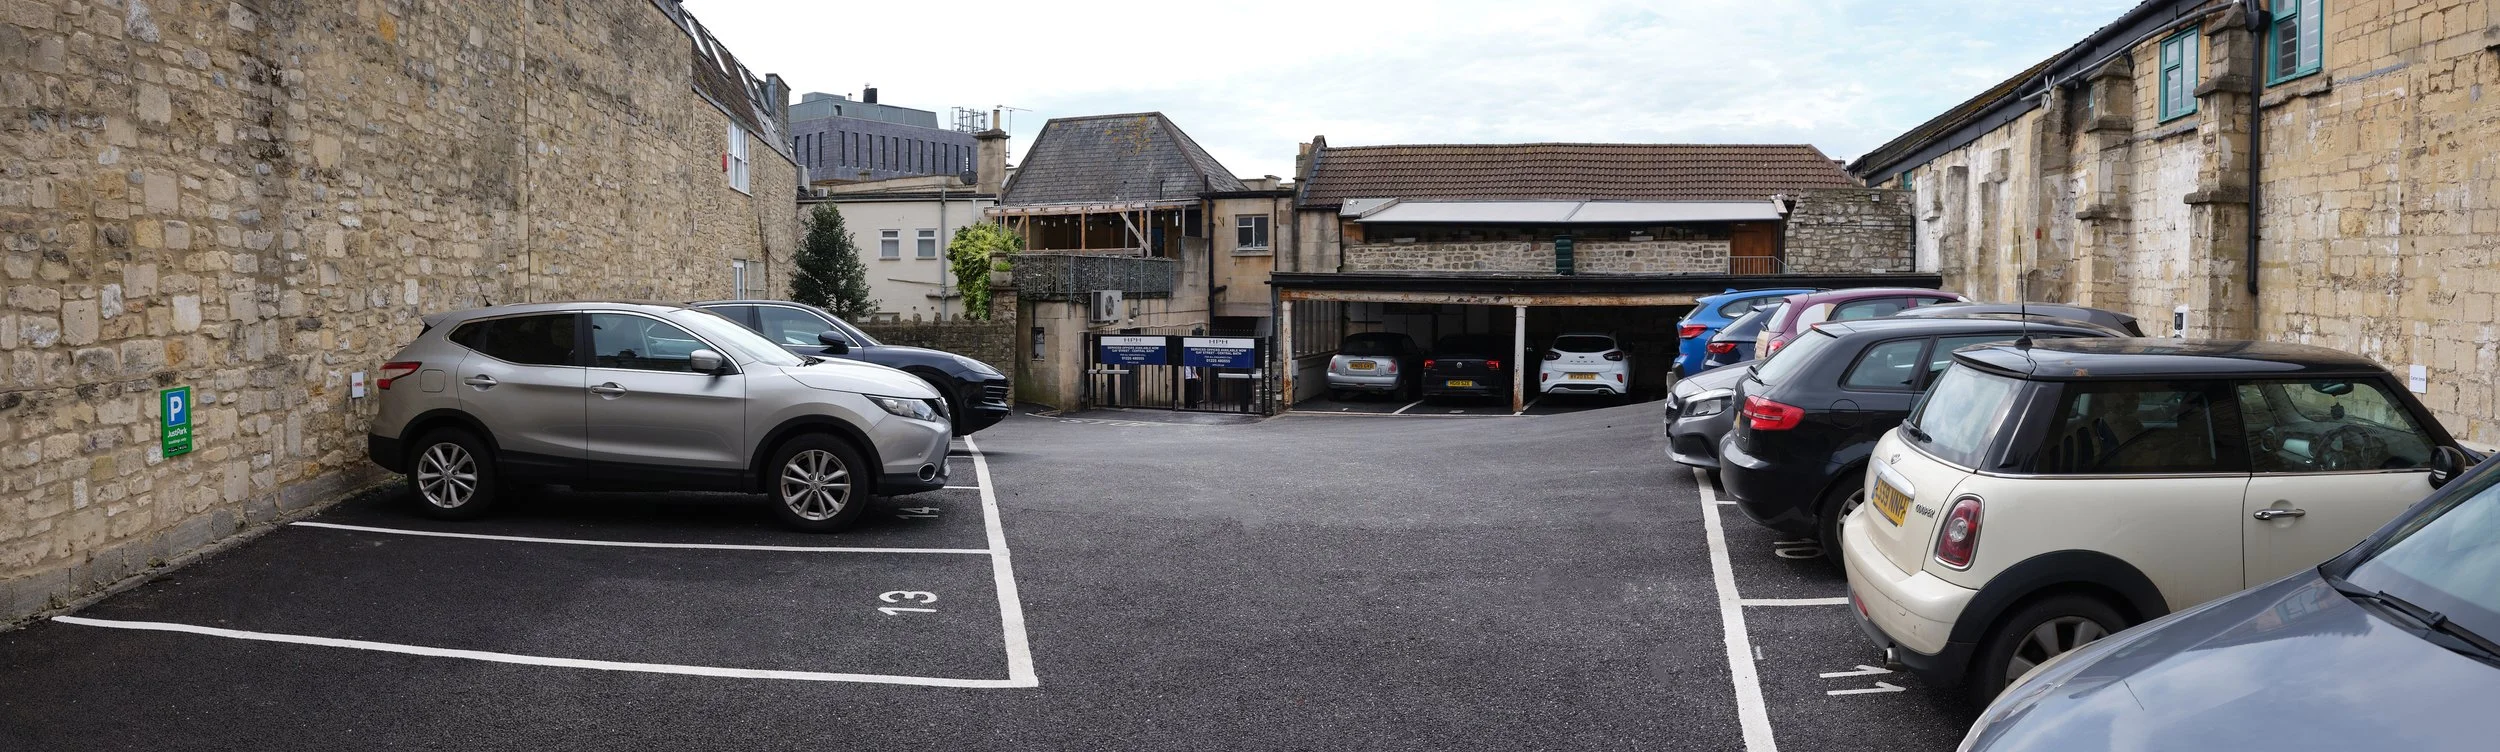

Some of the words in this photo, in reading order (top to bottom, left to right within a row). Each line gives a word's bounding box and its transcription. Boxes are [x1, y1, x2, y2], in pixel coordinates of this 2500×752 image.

[170, 396, 182, 422] P
[167, 427, 187, 438] JustPark
[1916, 503, 1936, 519] COOPER
[878, 590, 938, 616] 13
[1819, 664, 1907, 696] 11
